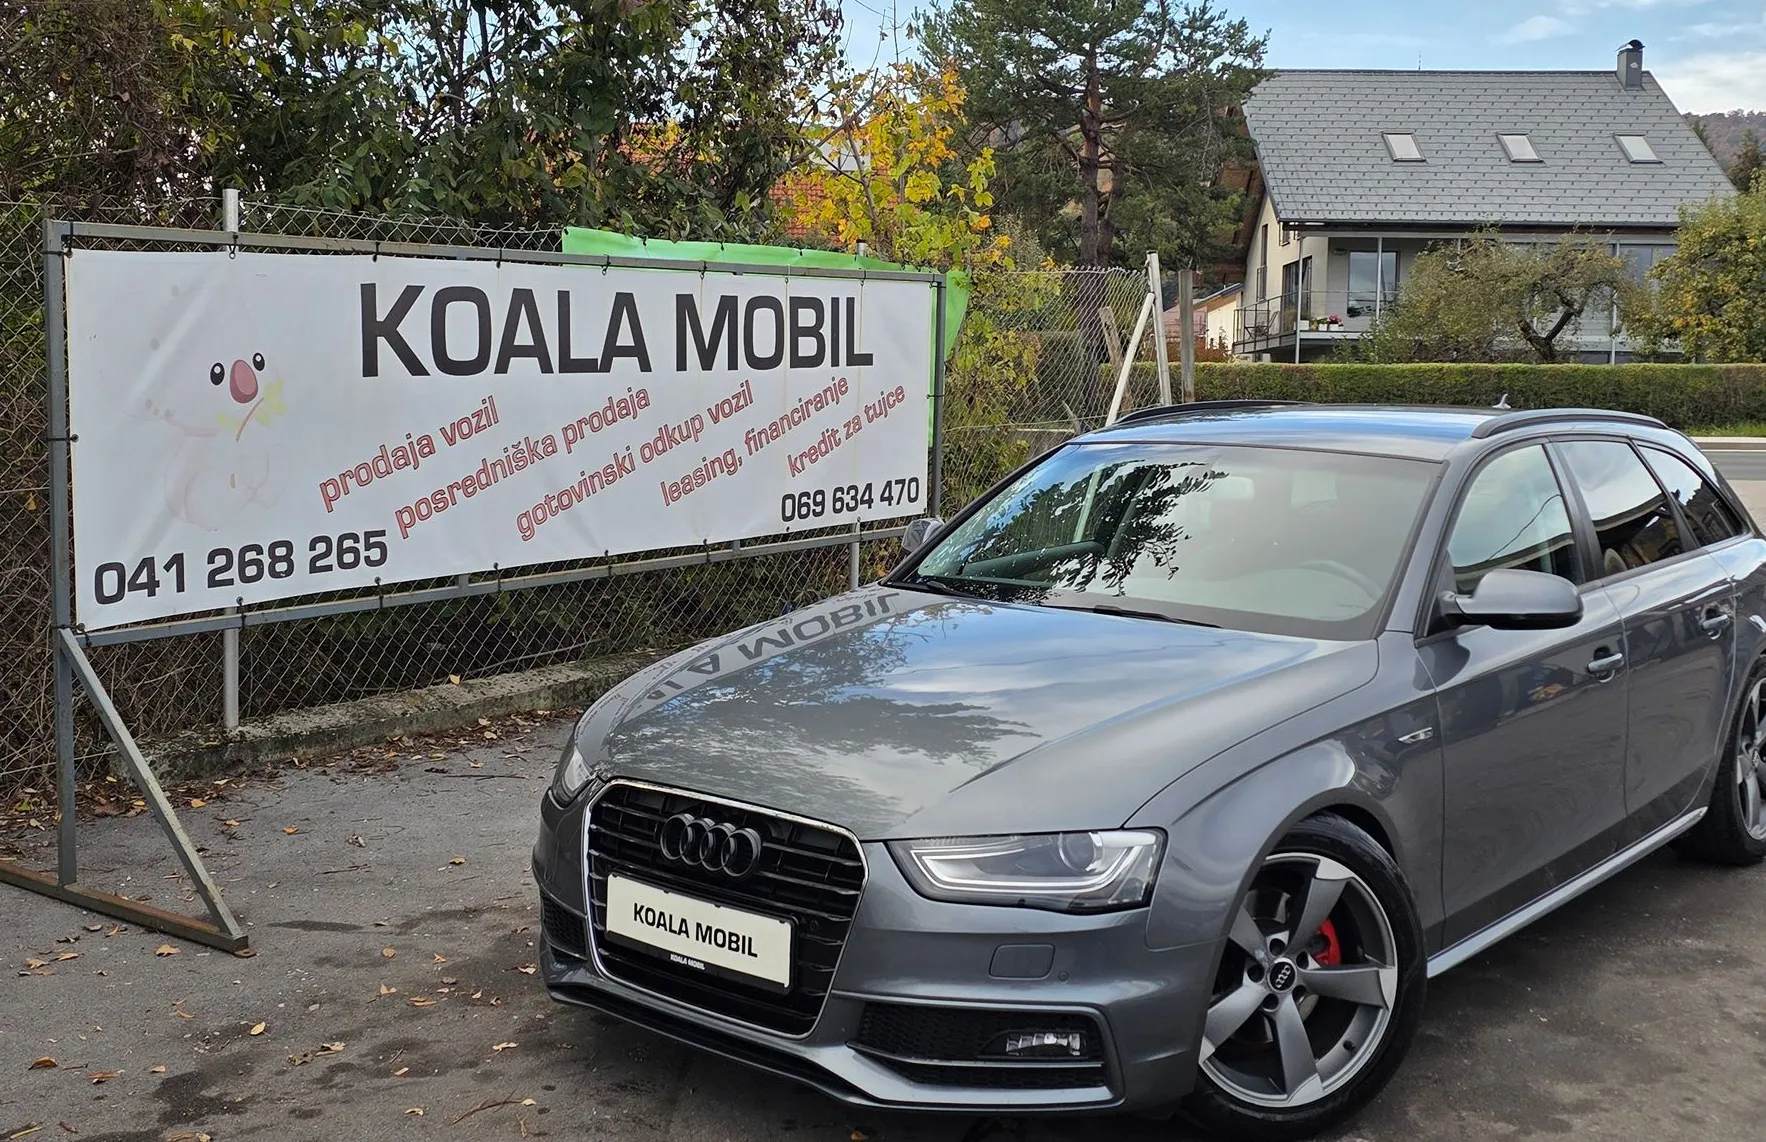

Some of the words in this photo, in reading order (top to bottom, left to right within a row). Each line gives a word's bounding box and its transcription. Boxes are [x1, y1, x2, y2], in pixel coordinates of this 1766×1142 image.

[360, 283, 653, 378] KOALA
[675, 293, 874, 372] MOBIL
[319, 432, 436, 512] prodaja
[439, 395, 499, 447] vozil
[395, 439, 557, 539] posredniška
[561, 386, 651, 454] prodaja
[516, 445, 635, 541] gotovinski
[640, 410, 704, 464] odkup
[707, 380, 754, 426] vozil
[660, 446, 743, 506] leasing,
[744, 376, 849, 451] financiranje
[787, 426, 842, 477] kredit
[843, 415, 863, 440] za
[864, 383, 906, 425] tujce
[781, 488, 826, 523] 069
[832, 483, 874, 516] 634
[879, 476, 920, 506] 470
[94, 552, 186, 605] 041
[206, 539, 295, 589] 268
[308, 529, 389, 574] 265
[633, 902, 690, 939] KOALA
[695, 922, 758, 958] MOBIL
[670, 953, 688, 965] KOALA
[688, 958, 706, 971] MOBIL
